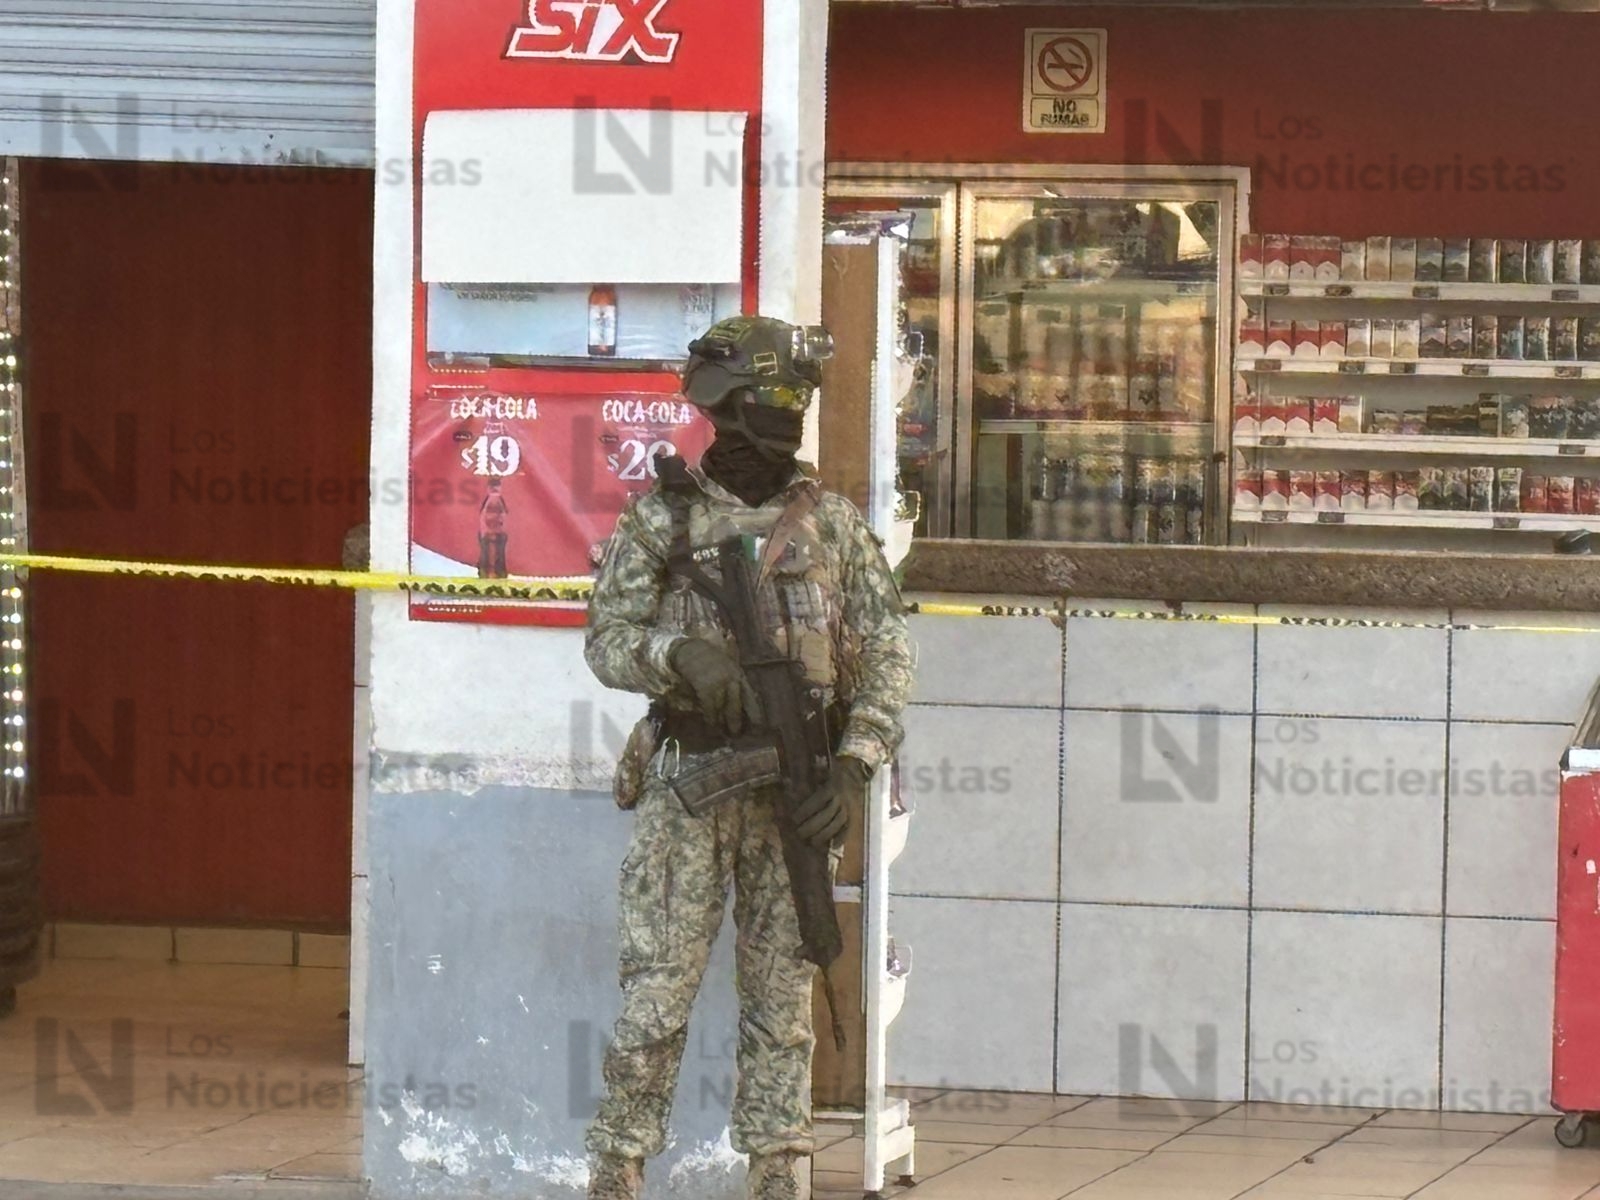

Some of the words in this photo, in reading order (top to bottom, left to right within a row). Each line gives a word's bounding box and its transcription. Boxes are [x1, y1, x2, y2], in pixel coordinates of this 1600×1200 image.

[1053, 98, 1076, 113] NO
[603, 400, 692, 424] COCA-COLA
[460, 436, 521, 476] $19
